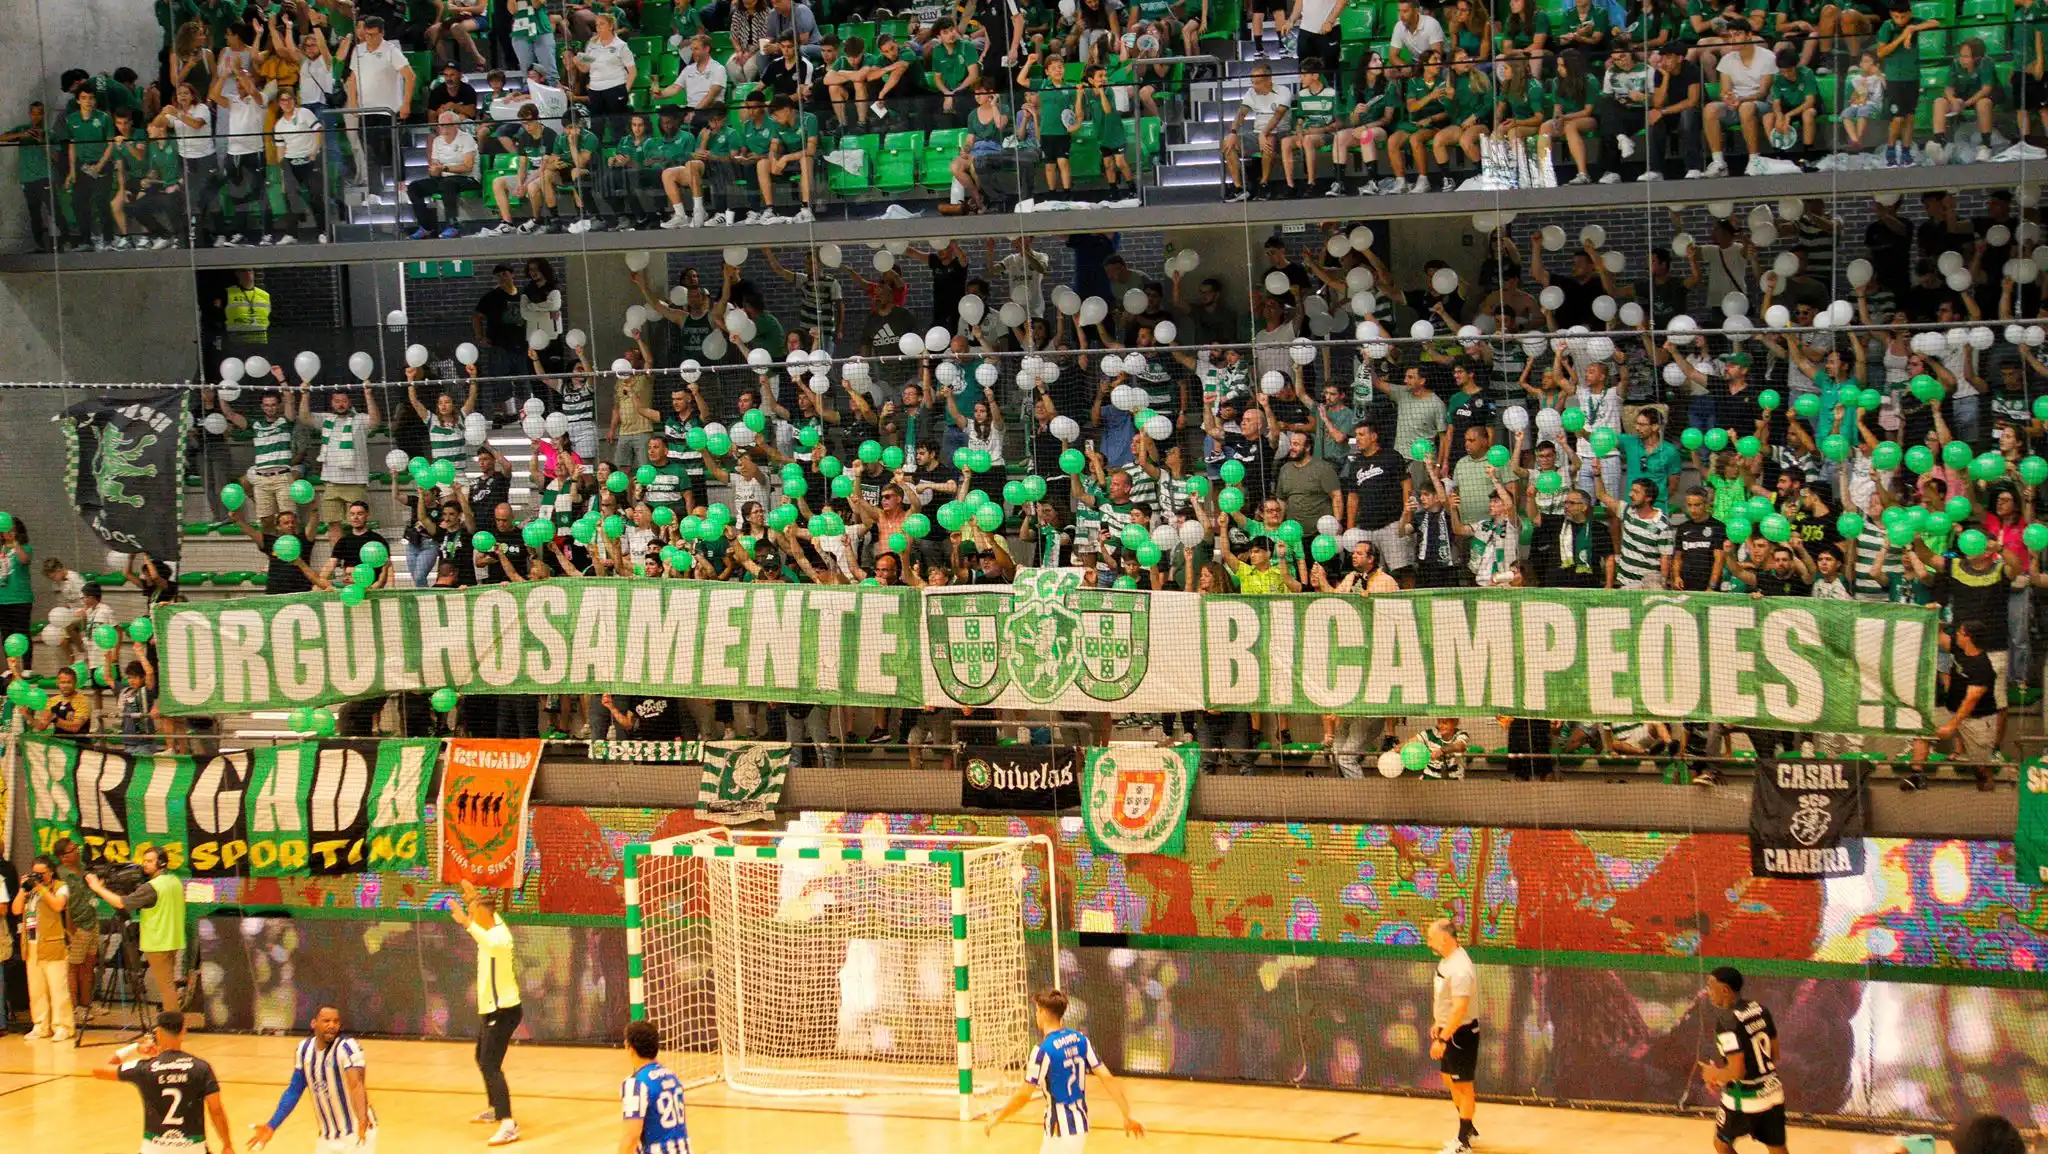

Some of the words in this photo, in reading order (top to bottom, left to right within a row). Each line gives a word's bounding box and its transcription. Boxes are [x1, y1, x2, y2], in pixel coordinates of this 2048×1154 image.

[1013, 568, 1081, 601] SCP
[168, 586, 898, 706] ORGULHOSAMENTE
[1207, 594, 1826, 723] BICAMPEÕES
[1855, 617, 1924, 730] !!
[25, 741, 426, 834] BRIGADA
[1777, 763, 1849, 789] CASAL
[1798, 794, 1830, 808] SCP
[191, 831, 418, 870] SPORTING
[1762, 847, 1852, 873] CAMBRA
[161, 1087, 184, 1125] 2
